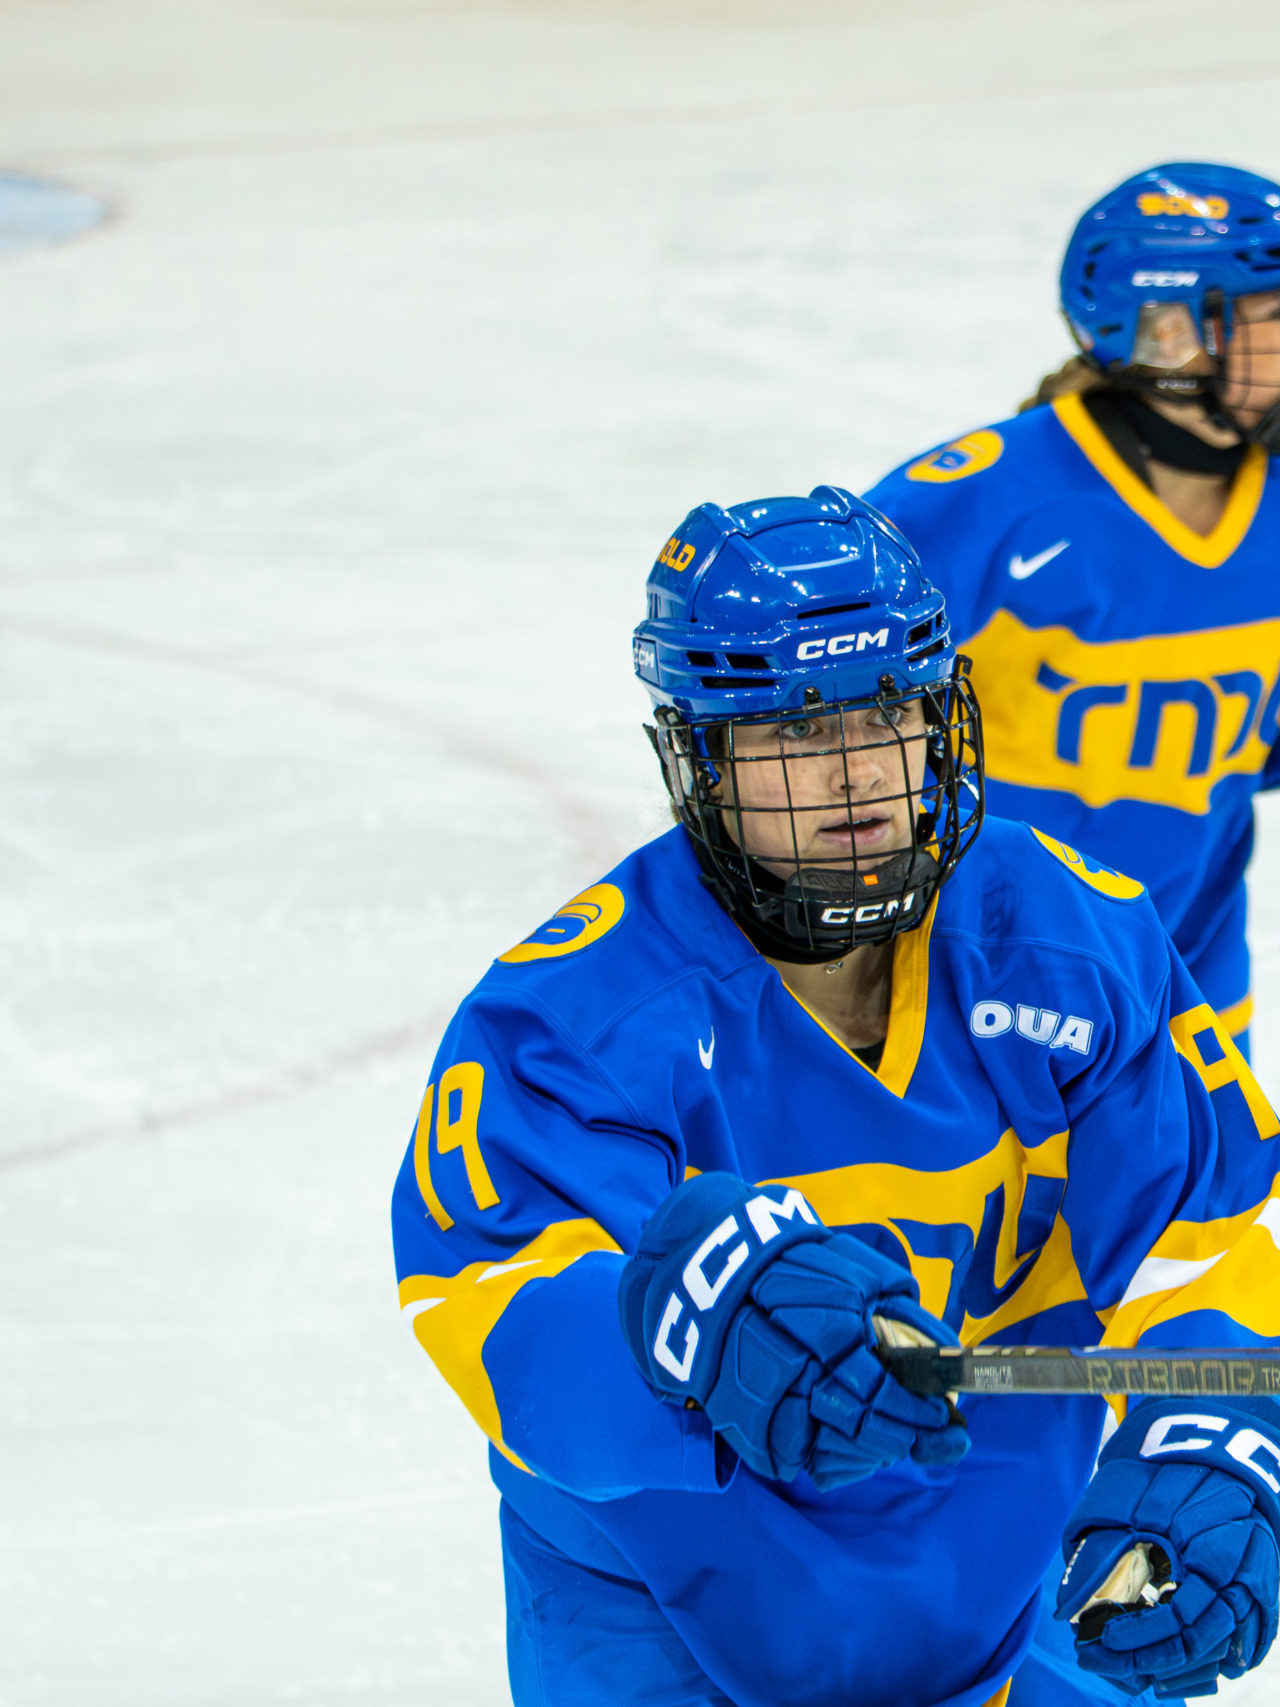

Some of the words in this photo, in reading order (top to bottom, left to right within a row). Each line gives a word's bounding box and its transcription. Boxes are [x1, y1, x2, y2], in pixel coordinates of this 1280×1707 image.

[1132, 270, 1199, 287] CCM
[657, 537, 696, 572] OLD
[796, 628, 889, 661] CCM
[820, 892, 915, 924] CCM
[971, 1001, 1093, 1055] OUA
[413, 1061, 500, 1232] 19
[653, 1189, 820, 1383] CCM
